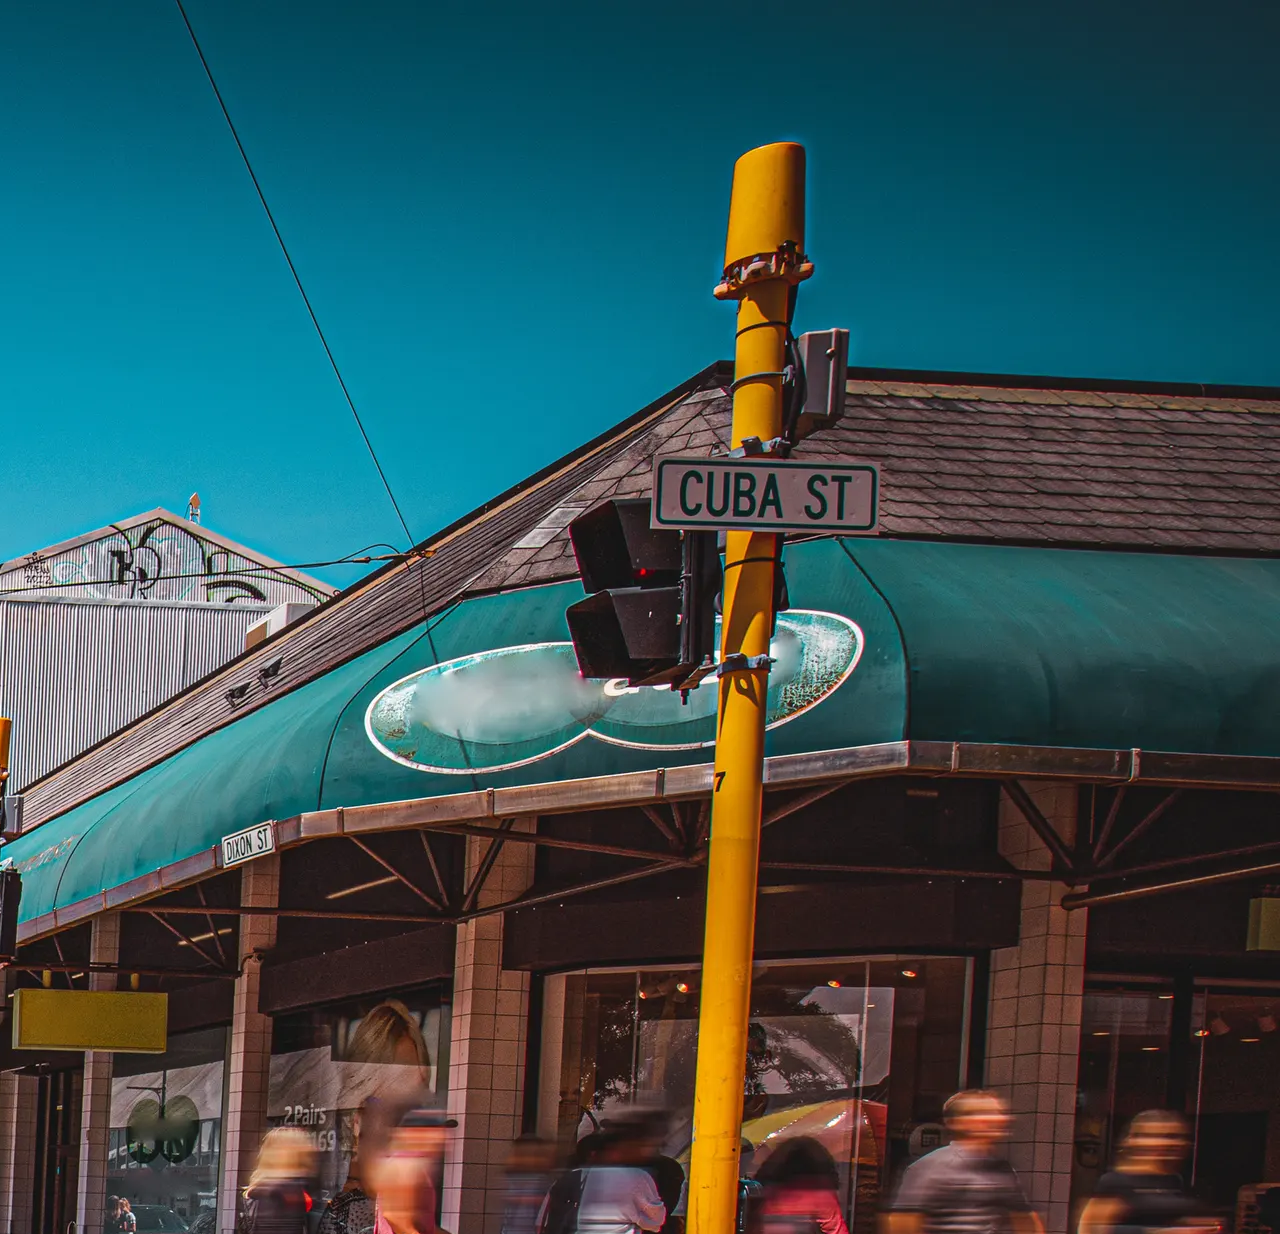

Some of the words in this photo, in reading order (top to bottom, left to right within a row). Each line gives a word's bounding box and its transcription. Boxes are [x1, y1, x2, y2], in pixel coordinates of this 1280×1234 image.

[679, 469, 783, 518] CUBA
[803, 473, 852, 520] ST
[715, 771, 726, 792] 7
[226, 833, 252, 861] DIXON
[257, 828, 268, 850] ST
[284, 1105, 293, 1126] 2
[294, 1103, 327, 1126] Pairs
